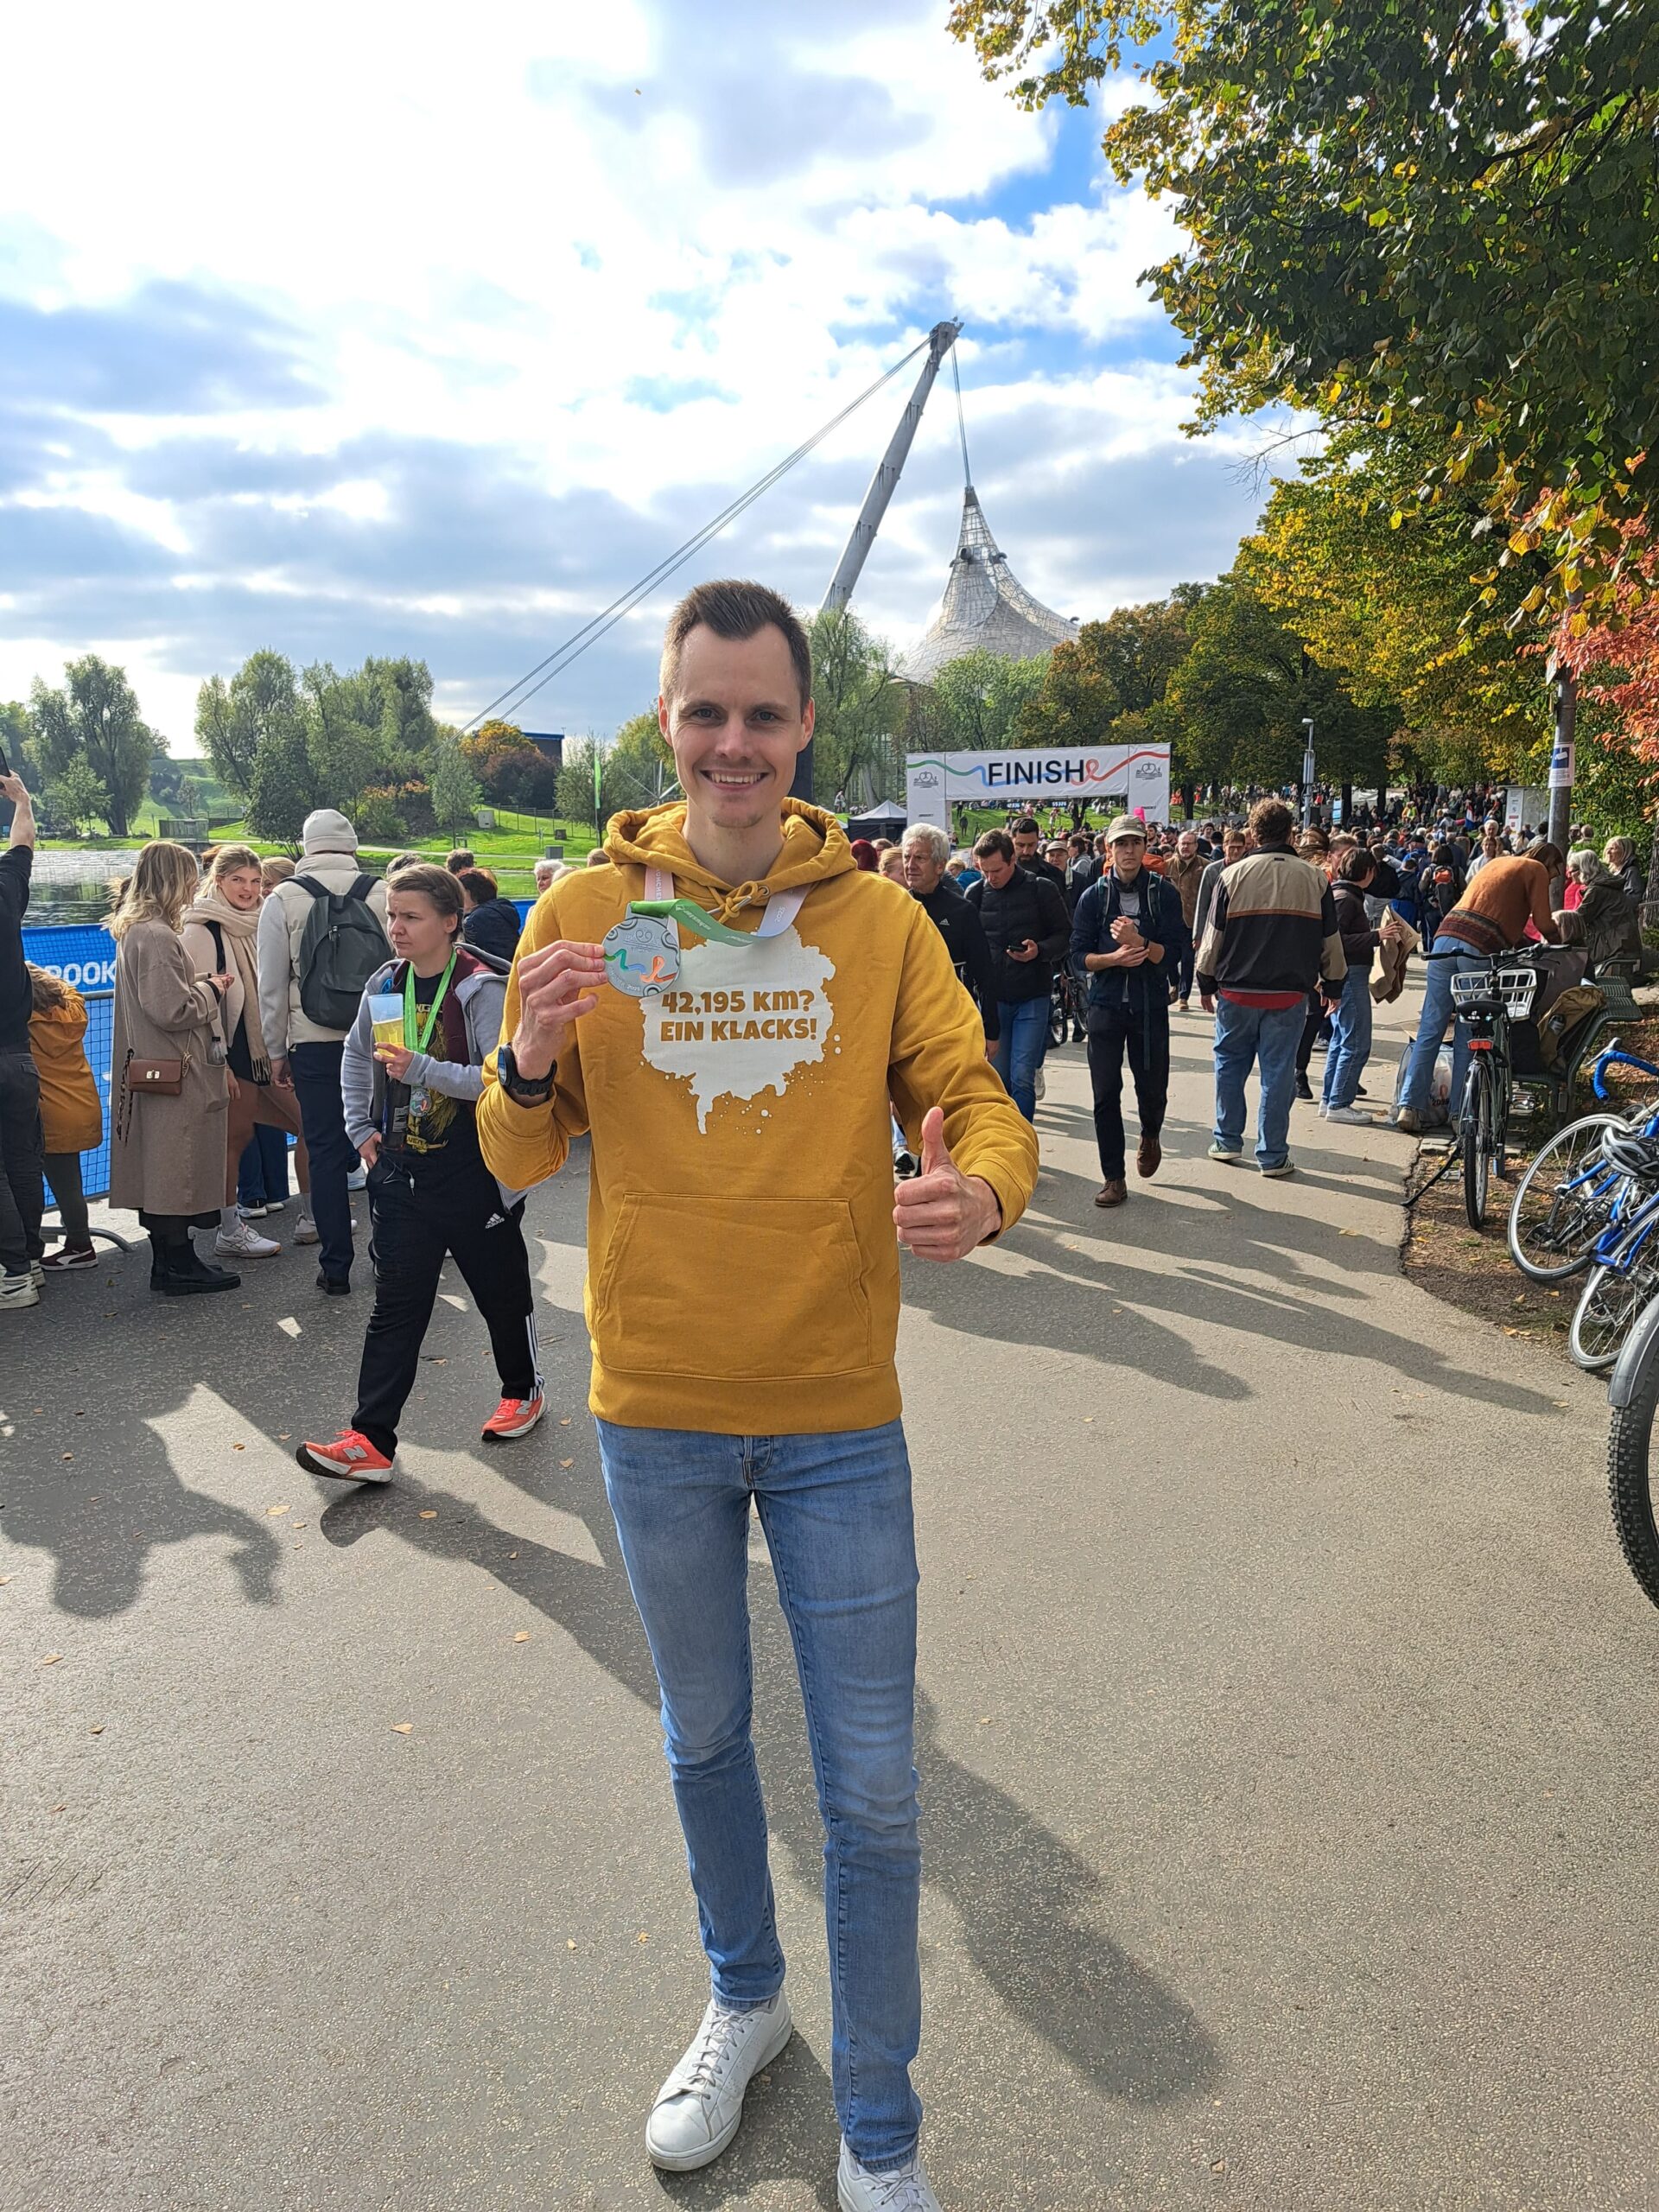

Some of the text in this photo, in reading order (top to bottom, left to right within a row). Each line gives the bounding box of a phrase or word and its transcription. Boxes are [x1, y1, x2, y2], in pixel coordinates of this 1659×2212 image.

[988, 760, 1084, 786] FINISH
[662, 991, 746, 1015] 42,195
[661, 1018, 817, 1041] EIN KLACKS!
